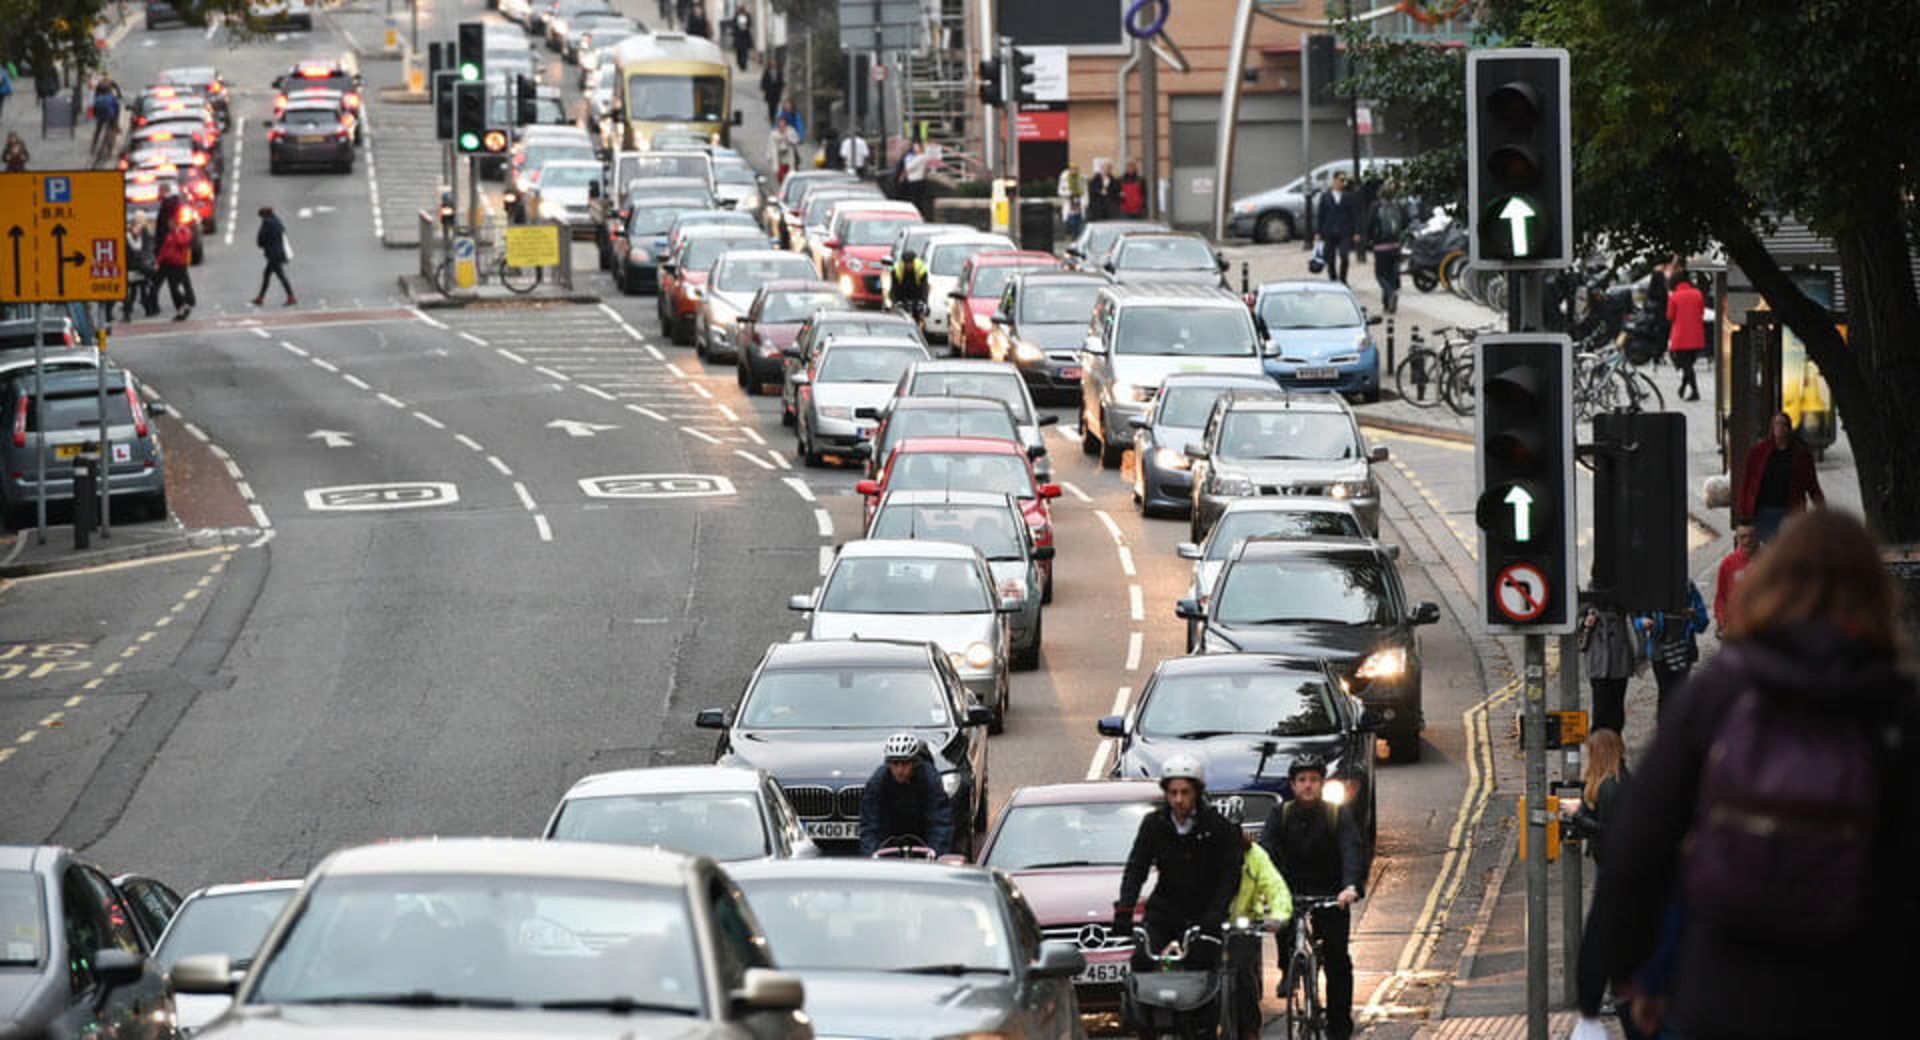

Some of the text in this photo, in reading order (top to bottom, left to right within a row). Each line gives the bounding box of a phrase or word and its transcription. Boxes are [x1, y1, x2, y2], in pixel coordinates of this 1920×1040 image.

[49, 179, 67, 201] P
[95, 241, 114, 262] H
[116, 447, 127, 459] L
[604, 481, 711, 493] 20
[328, 489, 434, 504] 20
[808, 823, 843, 837] K400
